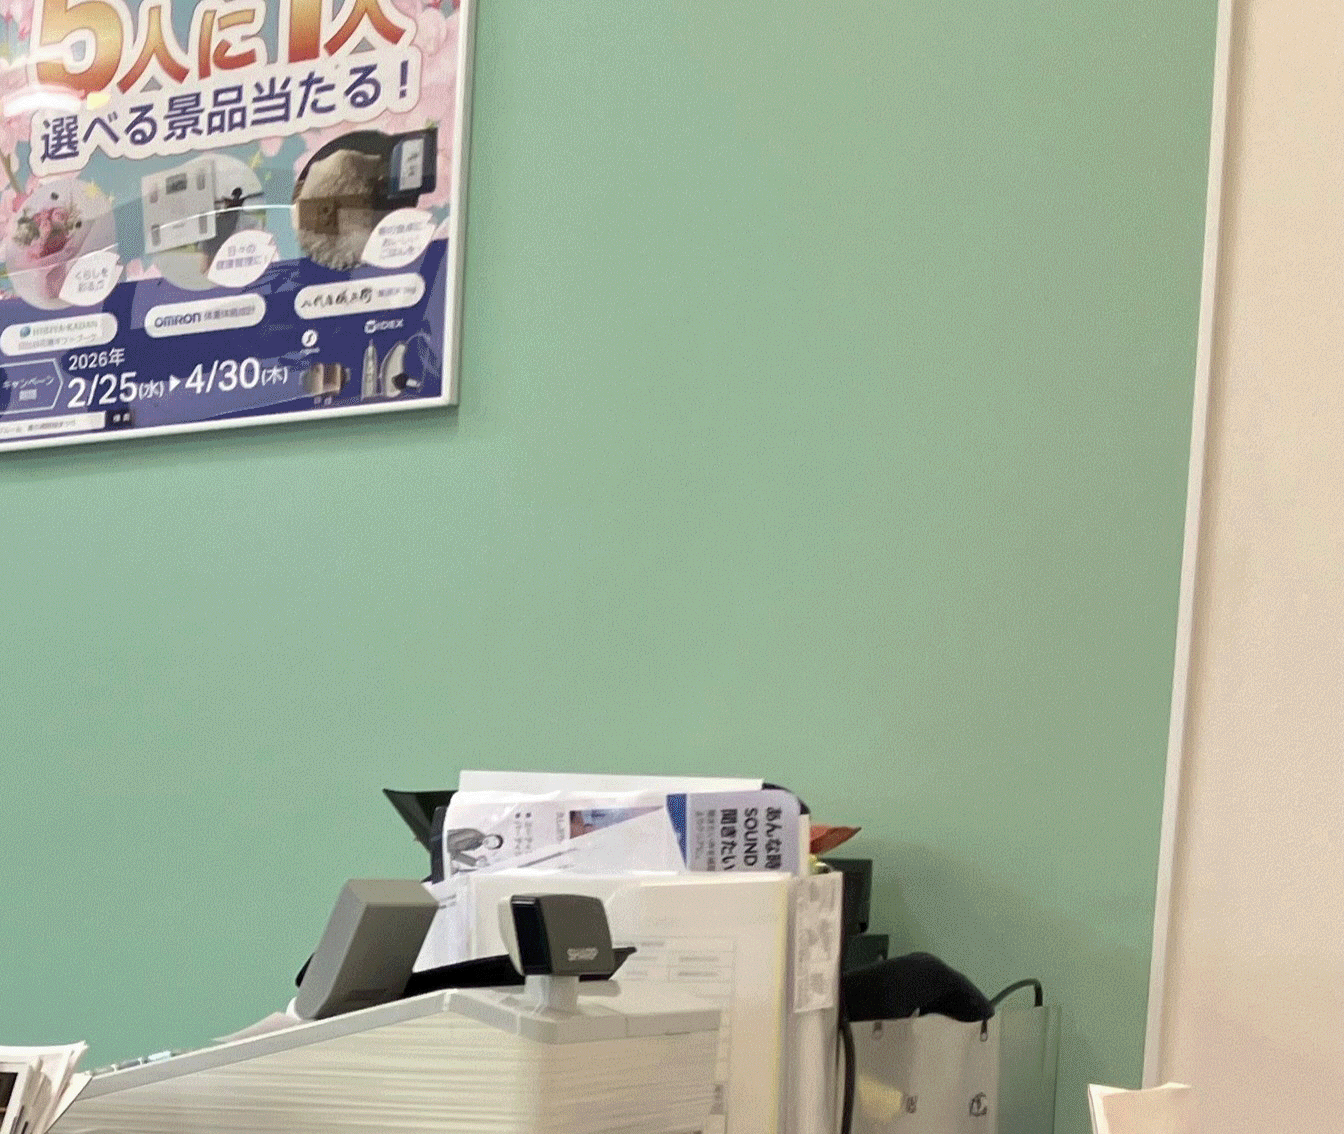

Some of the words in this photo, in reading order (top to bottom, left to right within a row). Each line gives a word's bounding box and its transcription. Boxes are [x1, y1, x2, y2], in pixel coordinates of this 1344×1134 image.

[154, 312, 202, 328] OMRON
[68, 347, 126, 372] 2026年
[2, 374, 55, 390] キャンペーン
[67, 371, 165, 408] 2/25(水)
[185, 356, 289, 394] 4/30(木)
[744, 807, 758, 866] SOUND
